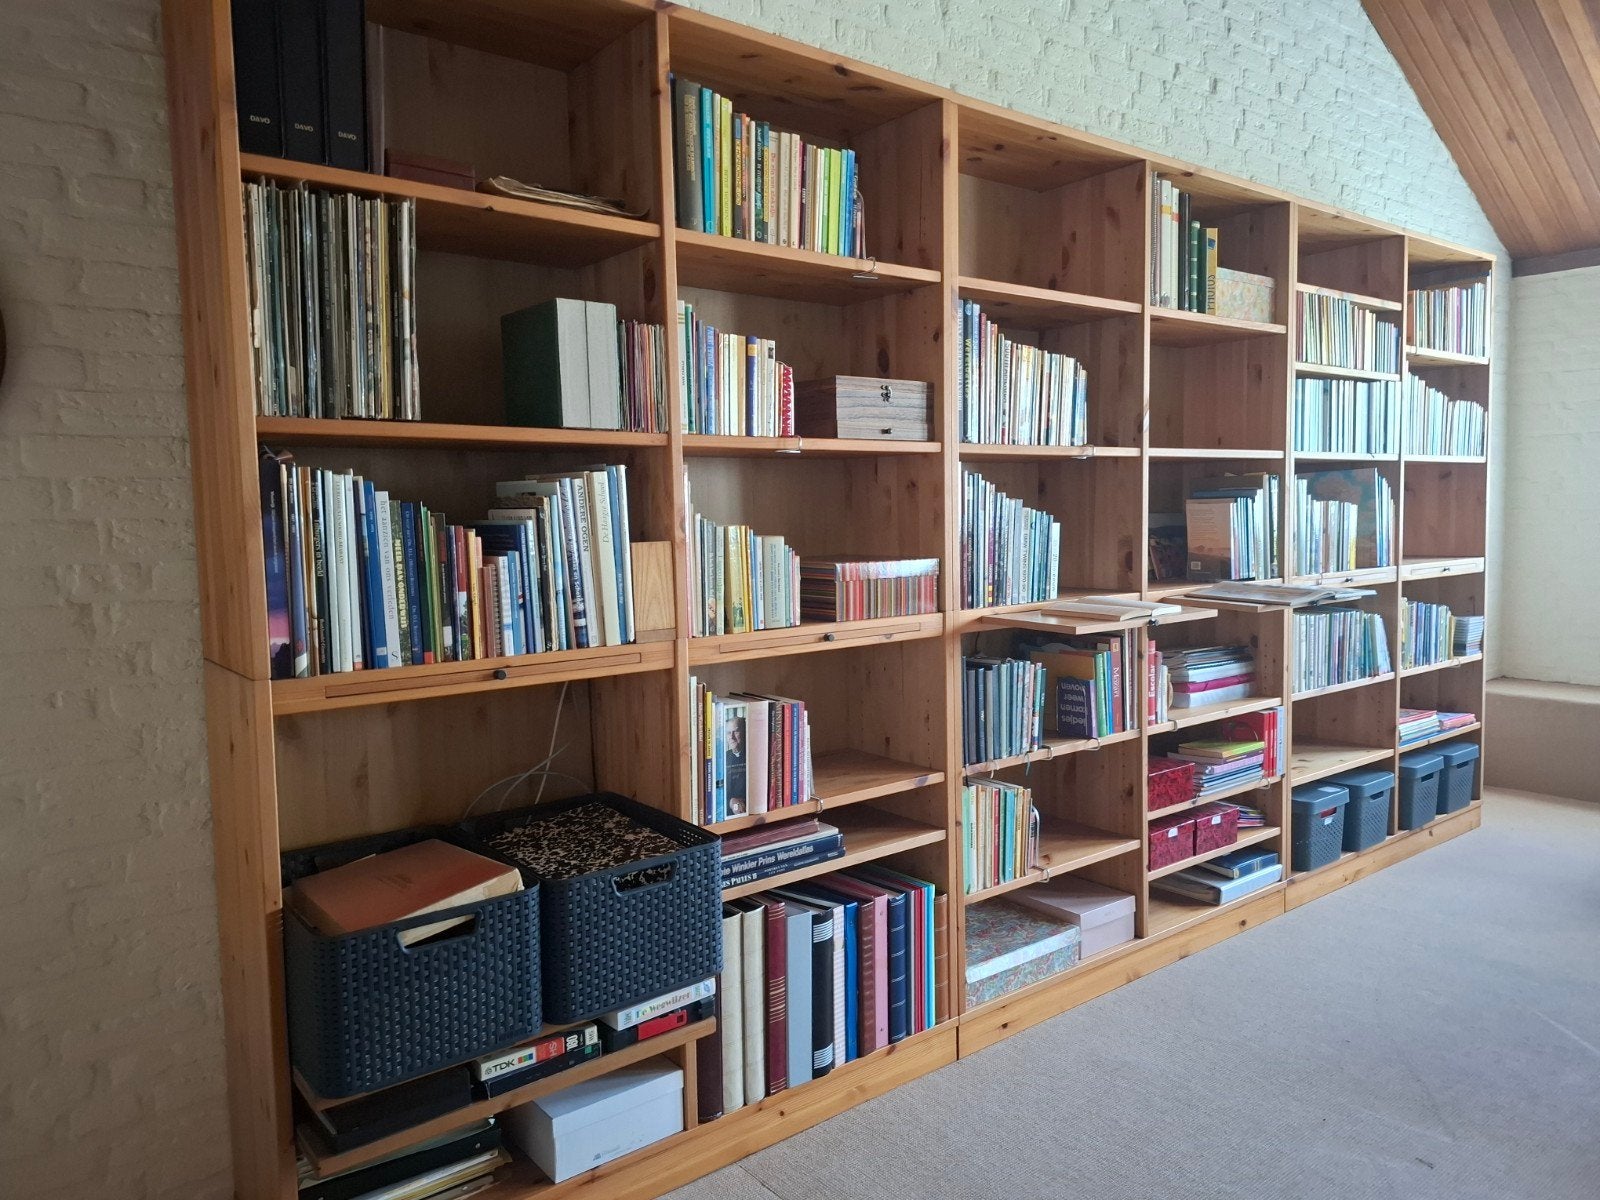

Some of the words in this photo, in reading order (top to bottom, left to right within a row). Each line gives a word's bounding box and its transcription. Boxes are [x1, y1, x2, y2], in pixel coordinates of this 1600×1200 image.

[250, 114, 271, 124] DAVO
[294, 122, 314, 132] DAVO
[338, 130, 357, 140] DAVO
[380, 500, 389, 514] het
[576, 485, 587, 524] ANDERE
[581, 526, 589, 552] OGEN
[384, 550, 392, 565] van
[385, 568, 393, 581] ons
[387, 586, 396, 619] verleden
[1148, 664, 1156, 698] Escolar
[731, 860, 758, 874] Winkler
[758, 855, 776, 867] Prins
[776, 845, 814, 861] Wereldatlas
[492, 1058, 515, 1072] TDK
